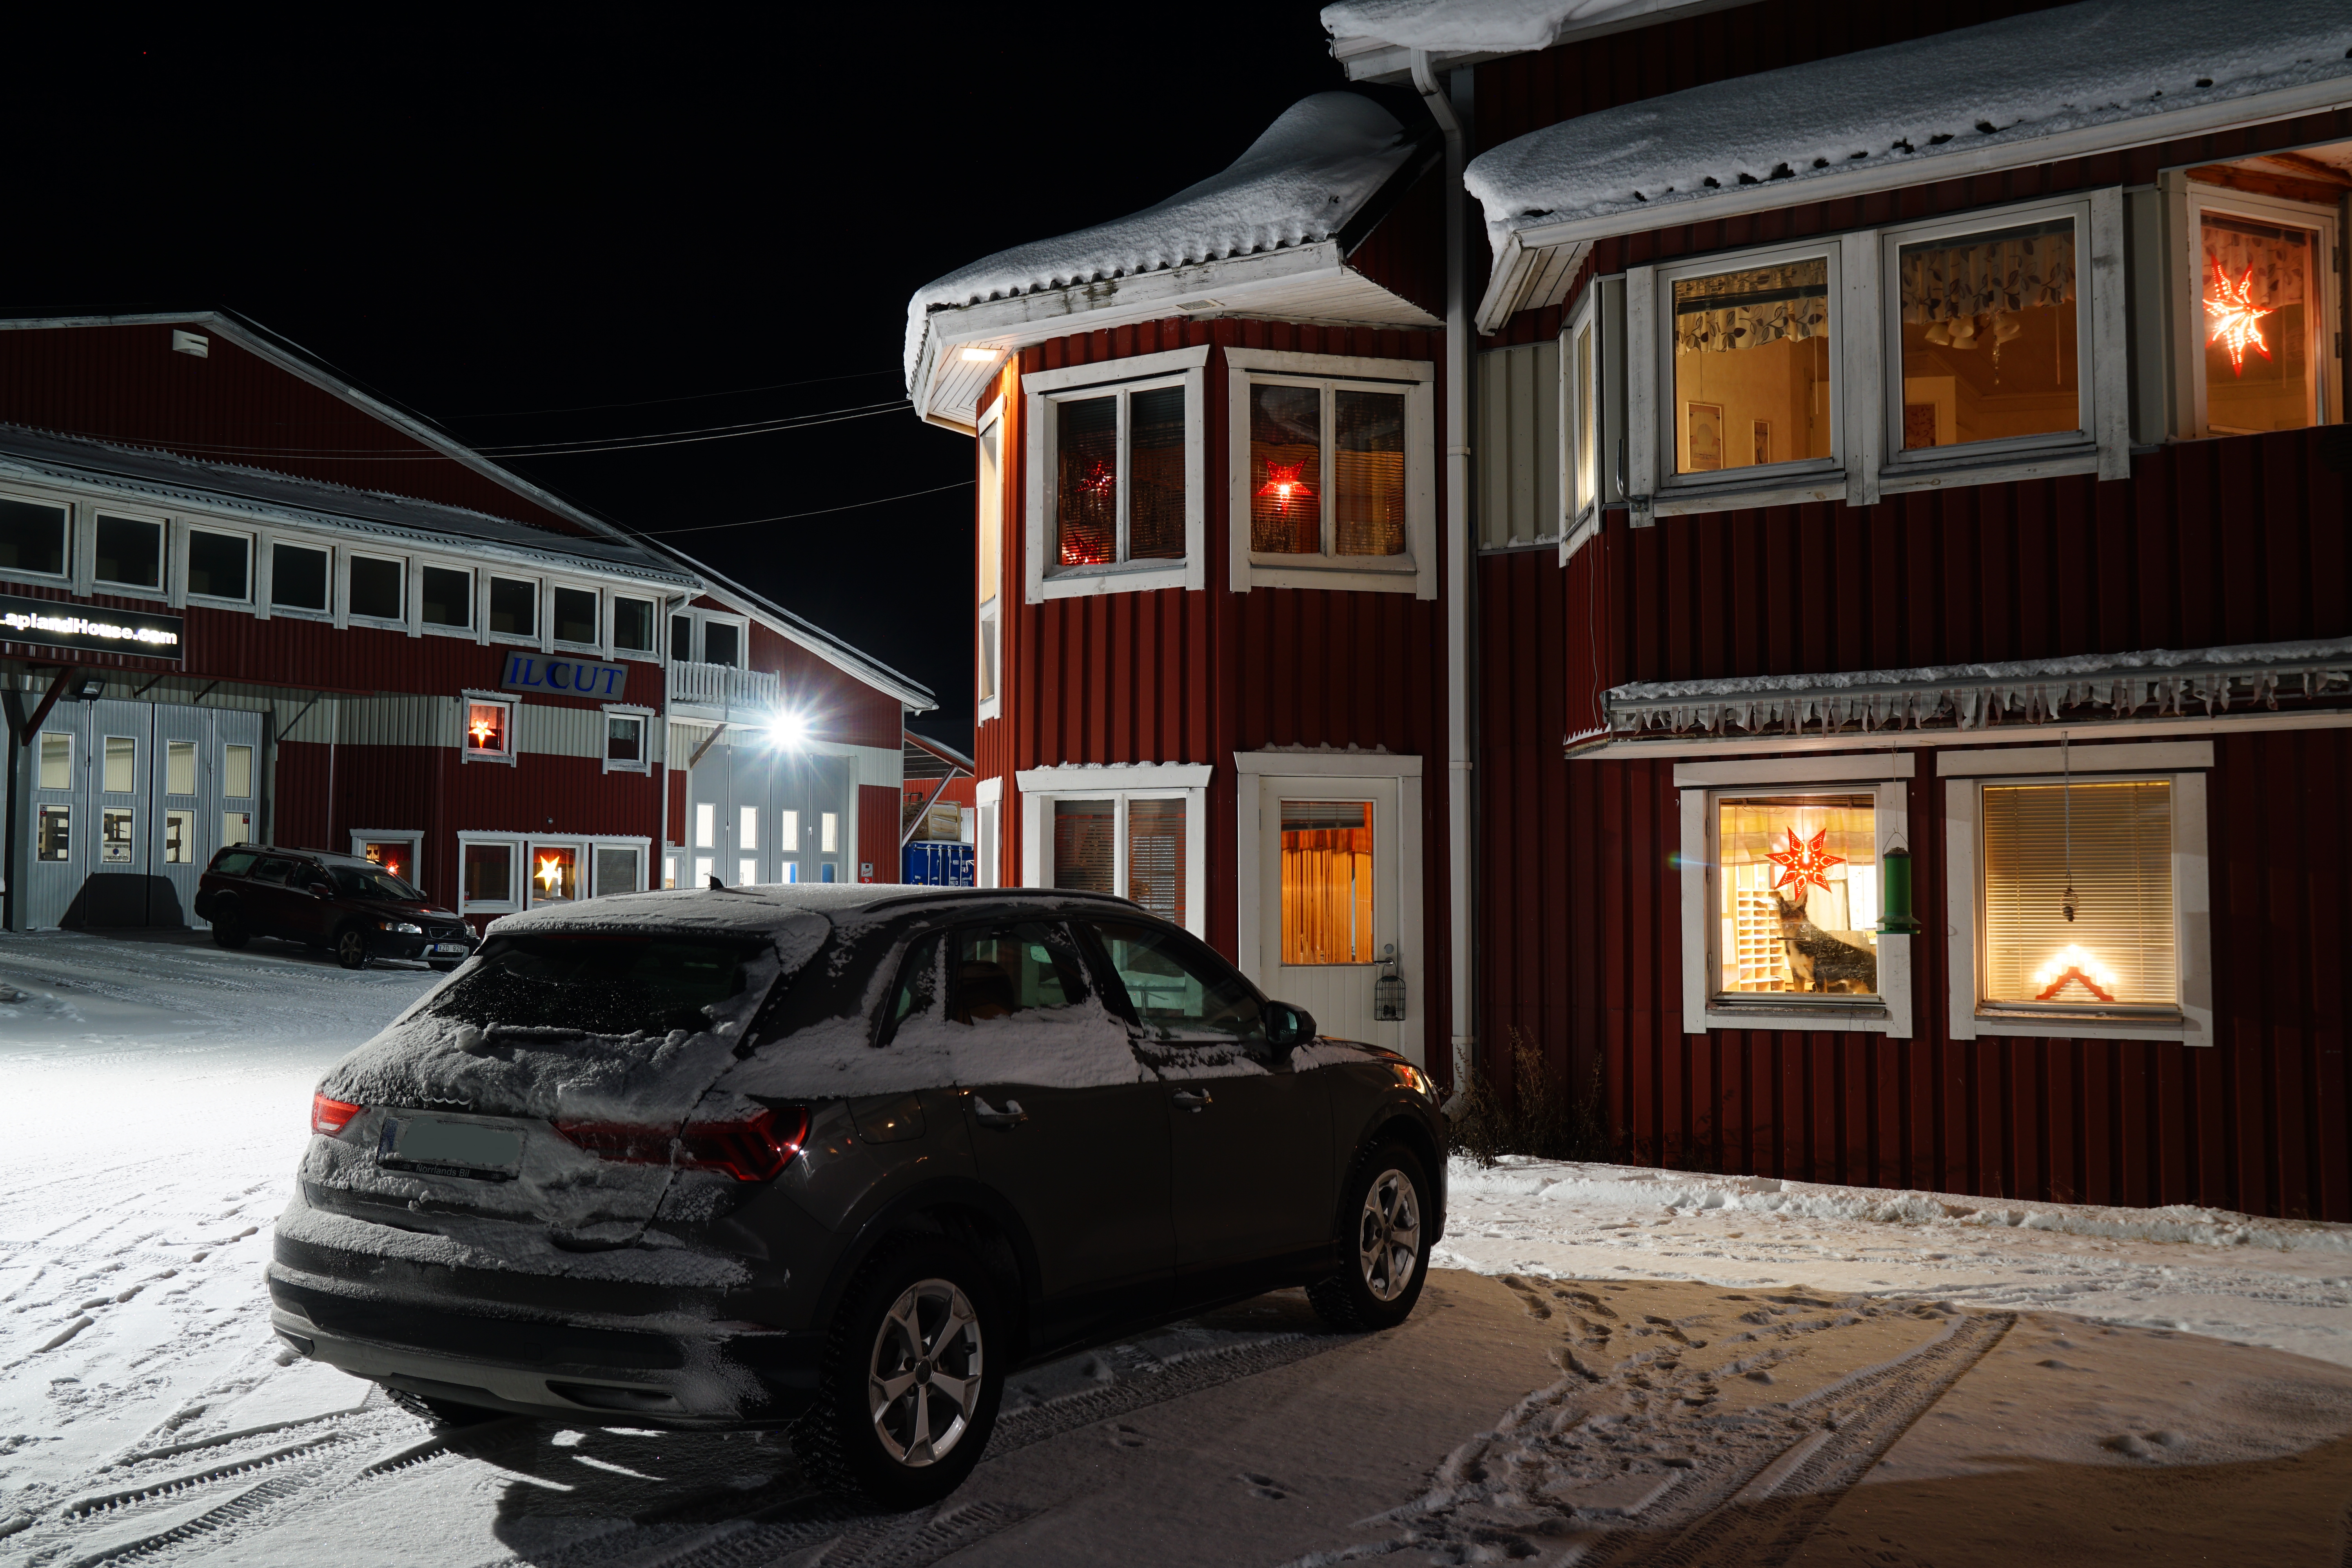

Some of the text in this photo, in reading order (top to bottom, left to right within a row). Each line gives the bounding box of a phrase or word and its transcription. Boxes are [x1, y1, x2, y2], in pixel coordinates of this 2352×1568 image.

[508, 657, 622, 694] ILCUT
[416, 1163, 470, 1178] Norrlands Bil
